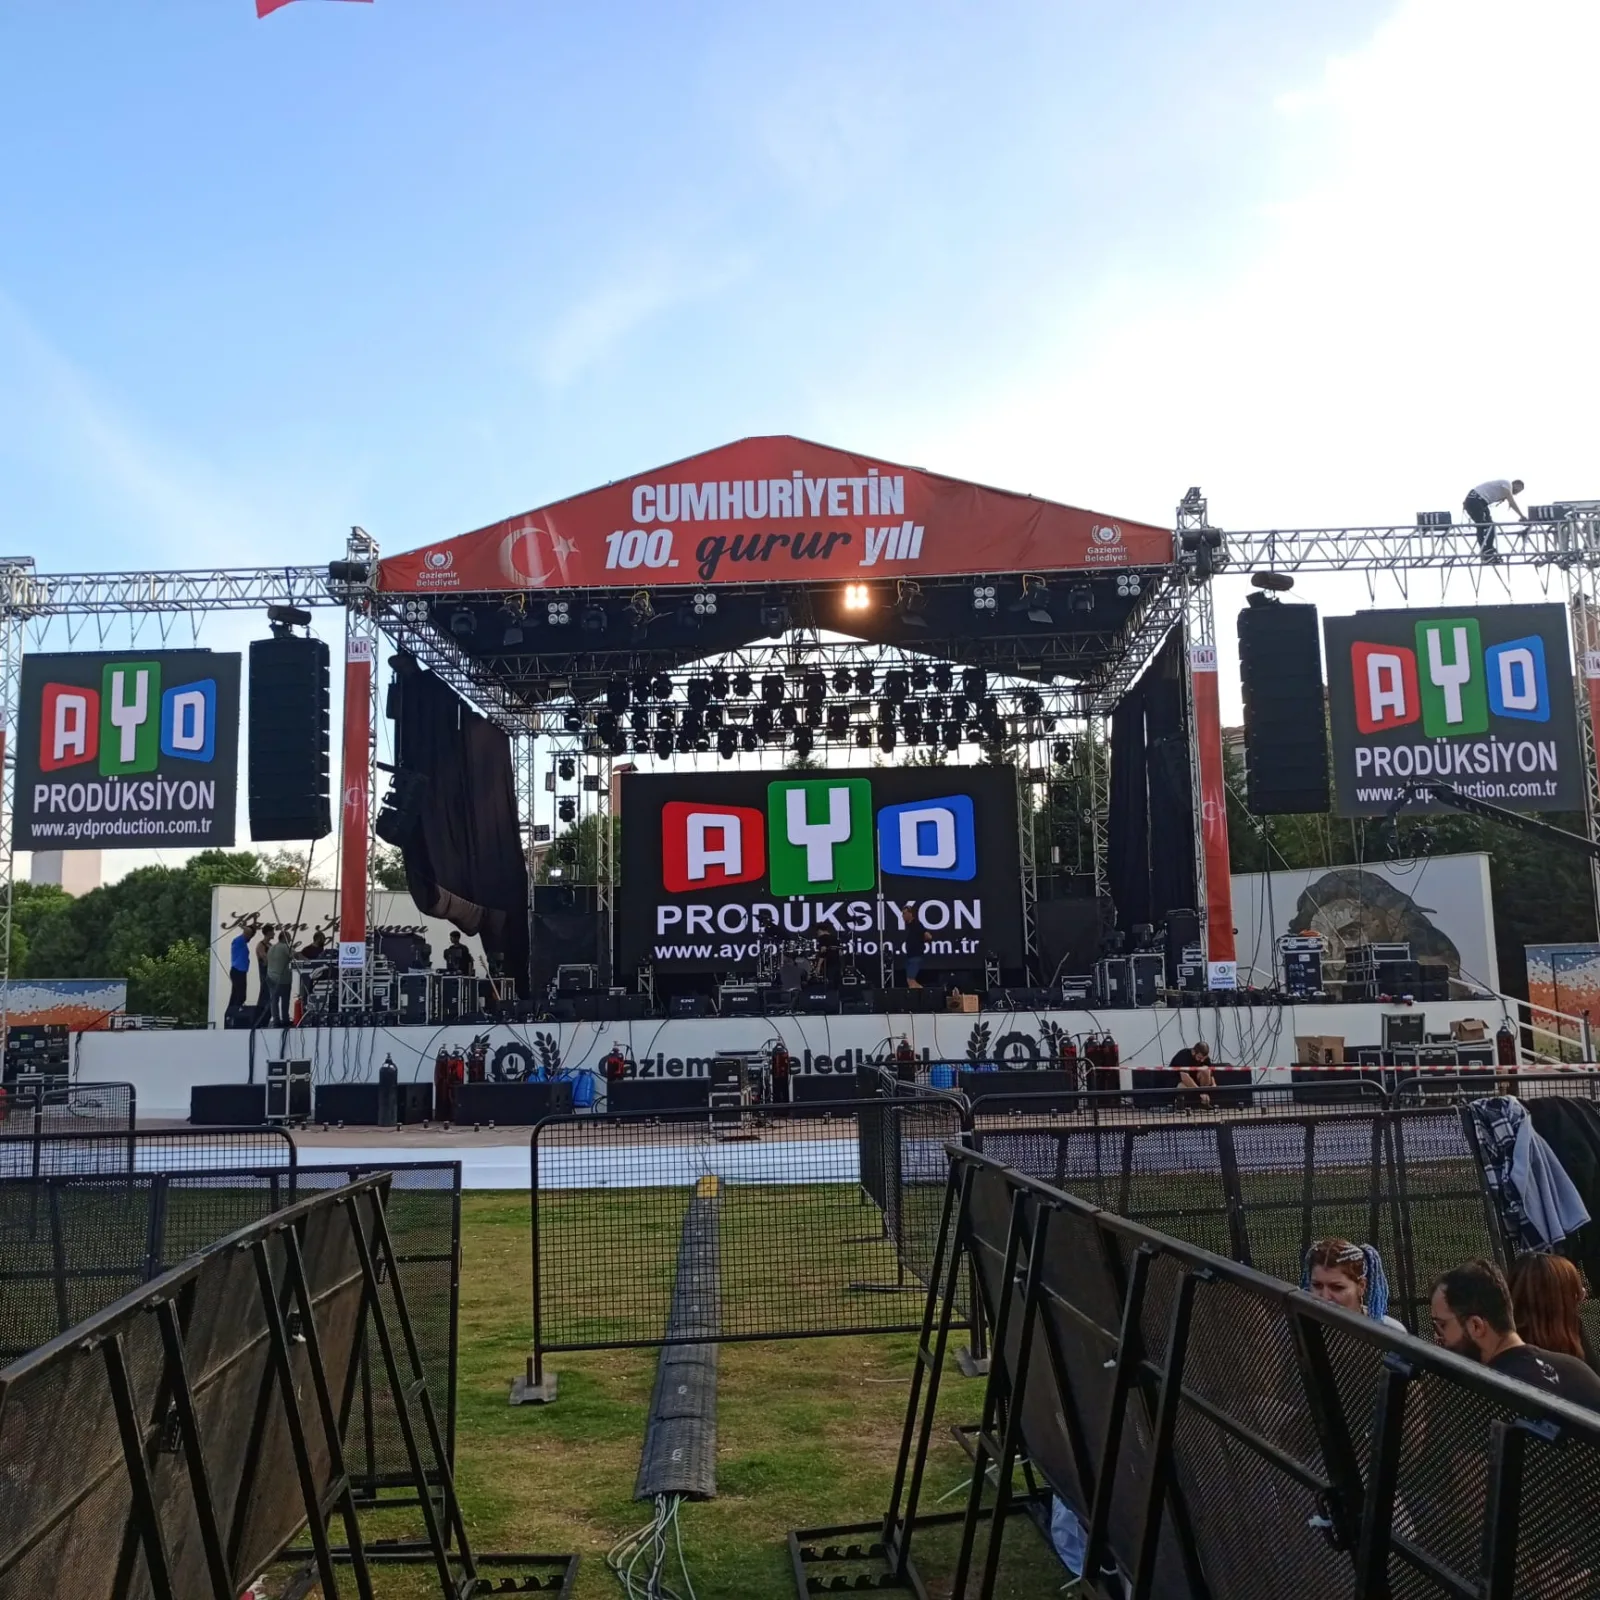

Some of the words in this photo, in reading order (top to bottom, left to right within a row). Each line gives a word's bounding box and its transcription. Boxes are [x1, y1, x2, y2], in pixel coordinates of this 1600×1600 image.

[632, 468, 904, 523] CUMHURİYETİN
[605, 528, 680, 569] 100.
[695, 531, 852, 580] gurur
[859, 521, 925, 566] yılı
[1366, 627, 1537, 724] AYD
[54, 670, 205, 762] AYD
[1355, 735, 1558, 777] PRODÜKSİYON
[33, 774, 215, 813] PRODÜKSİYON
[31, 818, 212, 839] www.aydproduction.com.tr
[686, 787, 956, 882] AYD
[657, 893, 981, 935] PRODÜKSİYON
